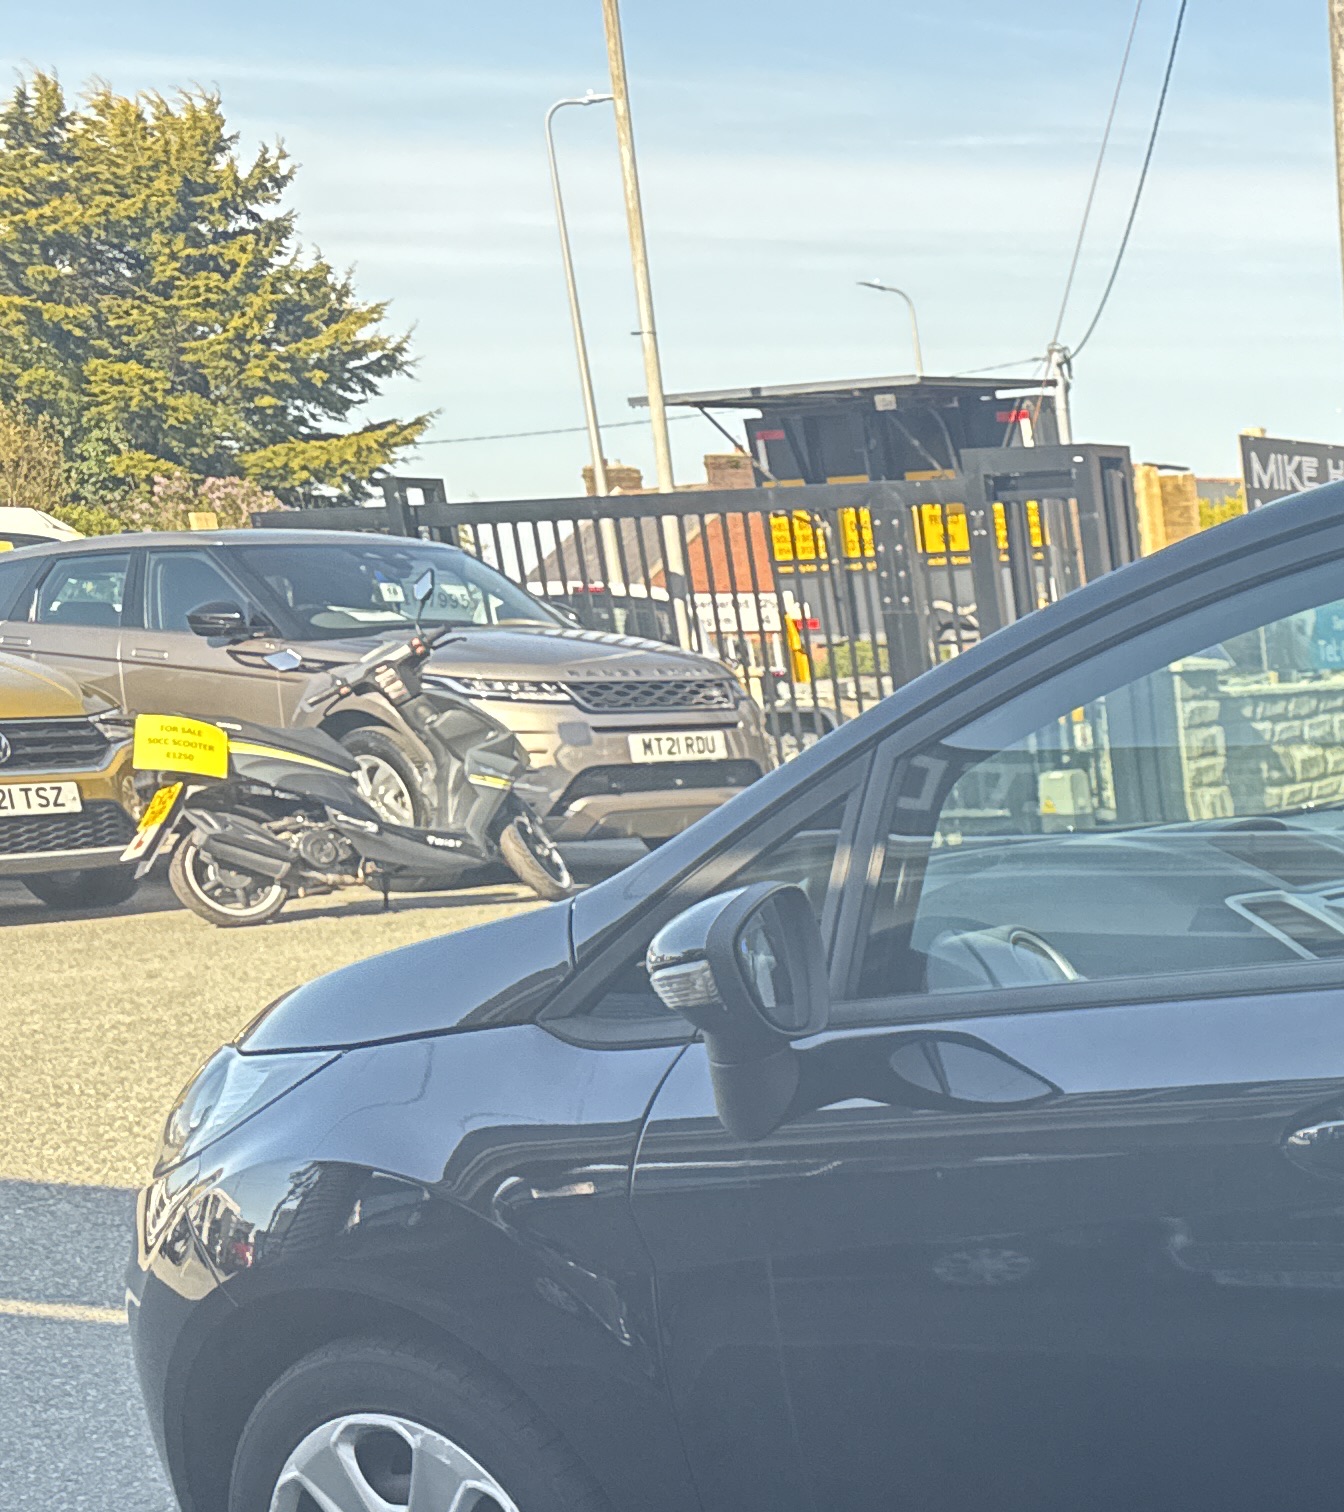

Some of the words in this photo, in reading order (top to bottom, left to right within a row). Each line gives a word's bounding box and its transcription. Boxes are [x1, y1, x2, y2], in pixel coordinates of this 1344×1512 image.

[1249, 451, 1320, 493] MIKE
[160, 724, 178, 732] FOR
[181, 727, 202, 737] SALE
[172, 739, 215, 752] SCOOTER
[642, 736, 681, 756] MT21
[685, 735, 716, 754] RDU
[19, 786, 66, 810] TSZ
